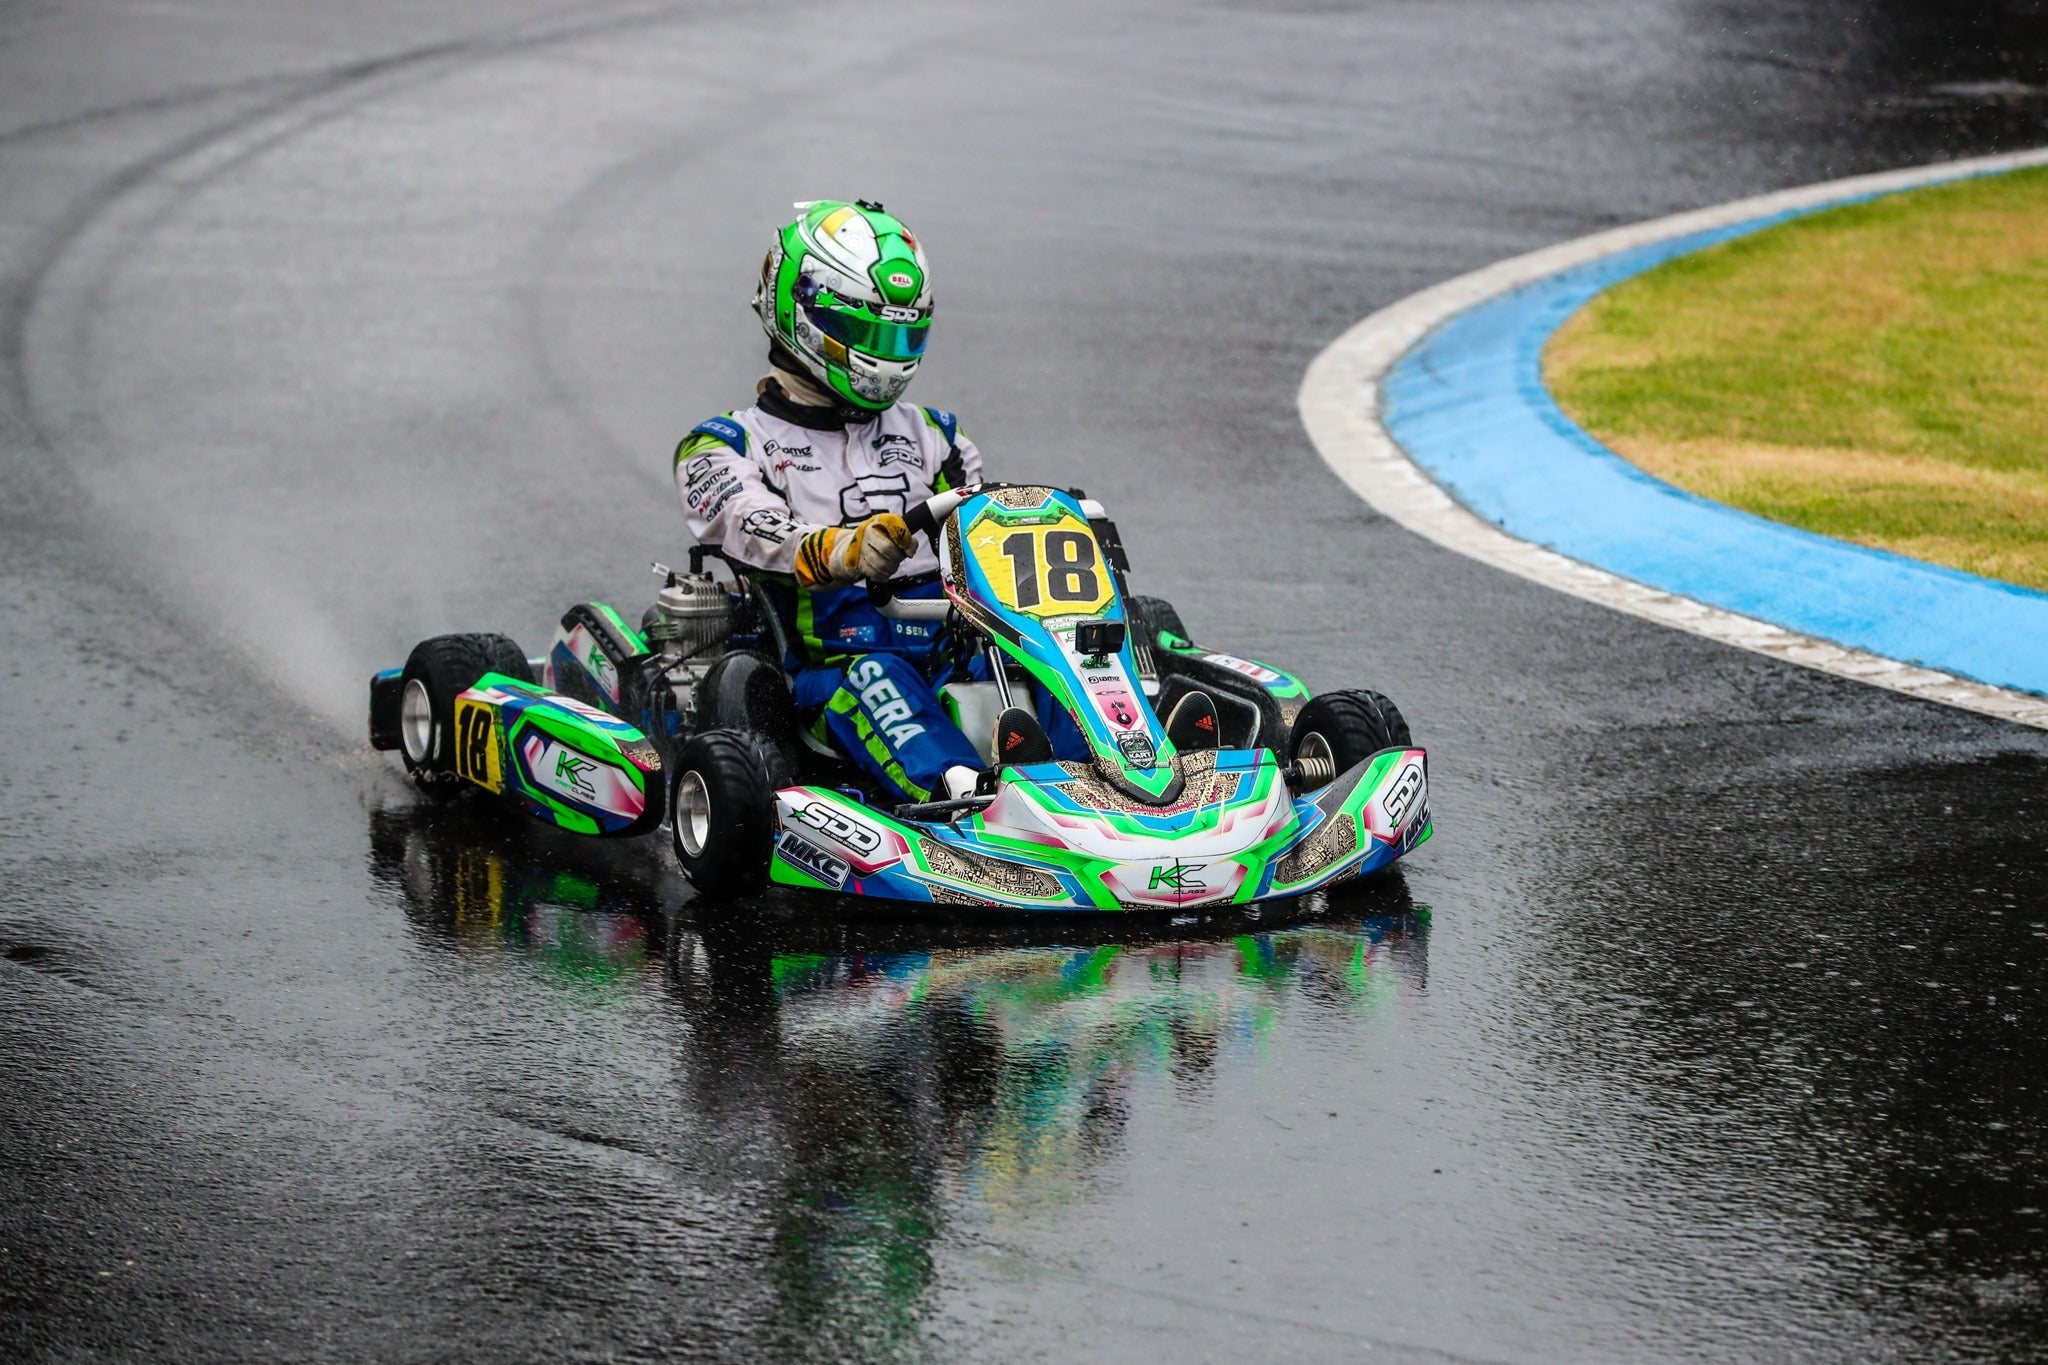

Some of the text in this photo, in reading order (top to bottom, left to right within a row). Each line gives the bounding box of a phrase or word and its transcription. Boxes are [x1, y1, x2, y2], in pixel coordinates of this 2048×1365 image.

[892, 276, 910, 285] BELL
[879, 305, 920, 322] SDD
[880, 448, 923, 469] SDD
[1003, 530, 1100, 609] 18
[905, 626, 930, 637] SERA
[848, 660, 927, 750] SERA
[458, 703, 493, 783] 18
[1128, 751, 1151, 759] KART
[556, 751, 598, 793] KC
[1383, 764, 1422, 826] SDD
[804, 802, 881, 851] SDD
[781, 833, 847, 879] MKC
[1148, 864, 1208, 889] KC
